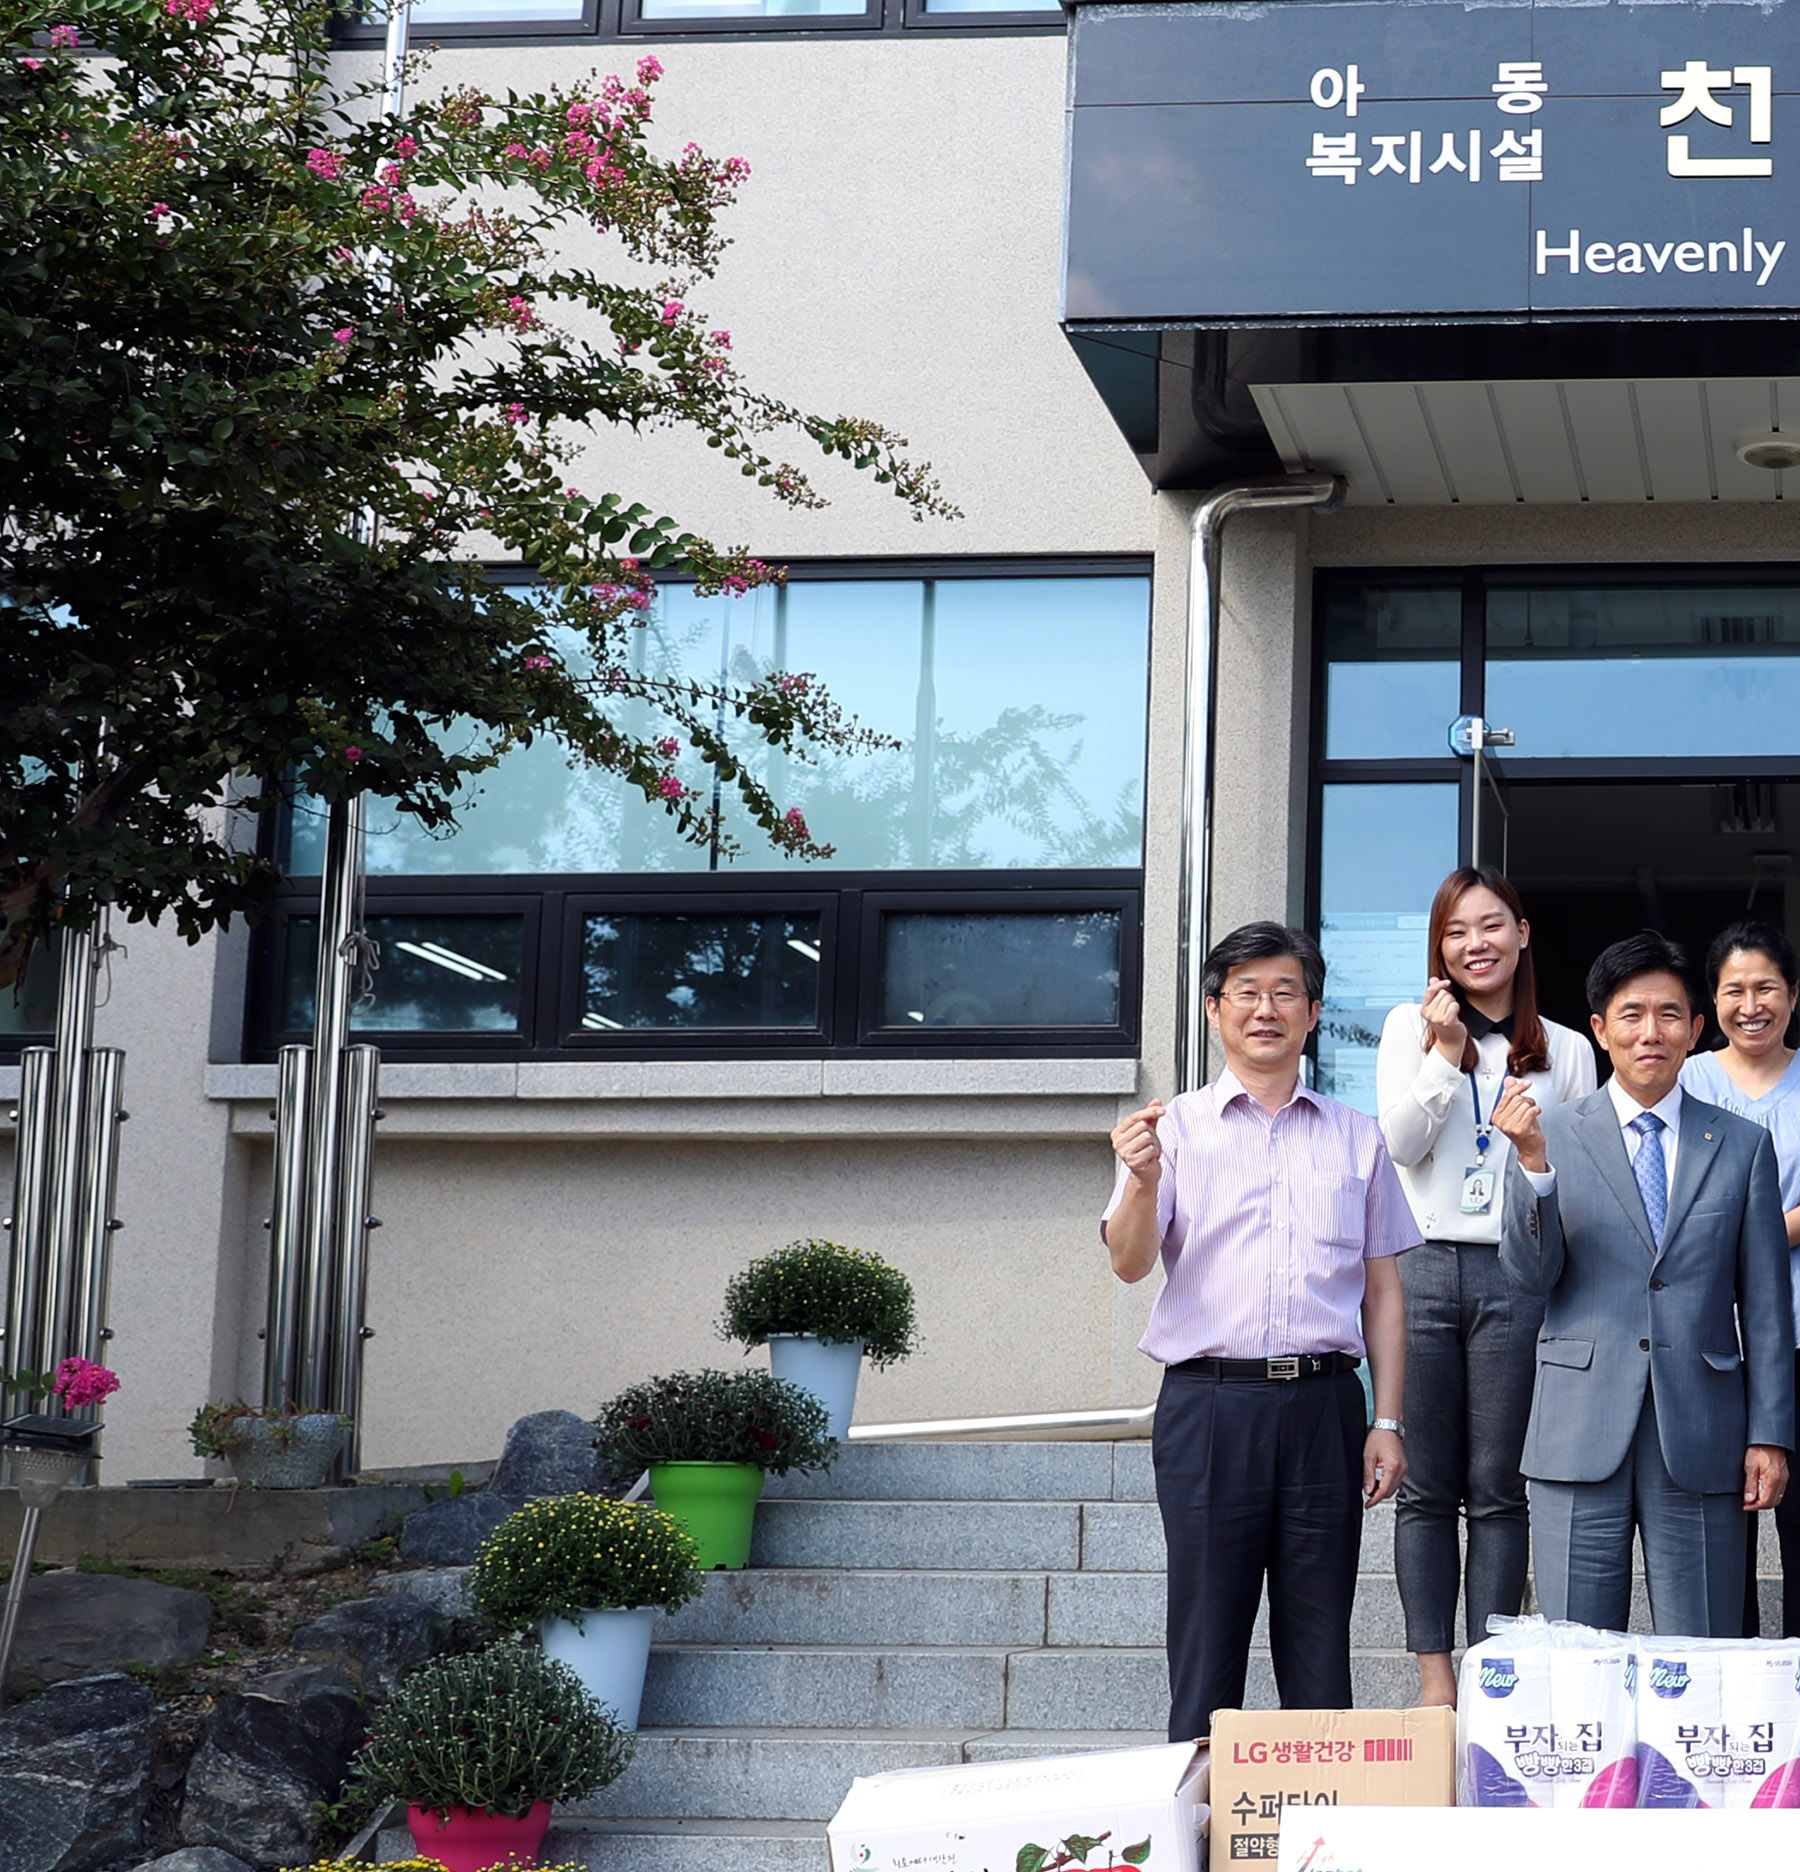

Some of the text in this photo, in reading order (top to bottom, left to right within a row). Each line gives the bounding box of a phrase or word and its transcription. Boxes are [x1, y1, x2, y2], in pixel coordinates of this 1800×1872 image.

[1305, 128, 1544, 185] 복지시설
[1535, 226, 1786, 286] Heavenly
[1480, 1667, 1519, 1688] New
[1650, 1667, 1691, 1689] New
